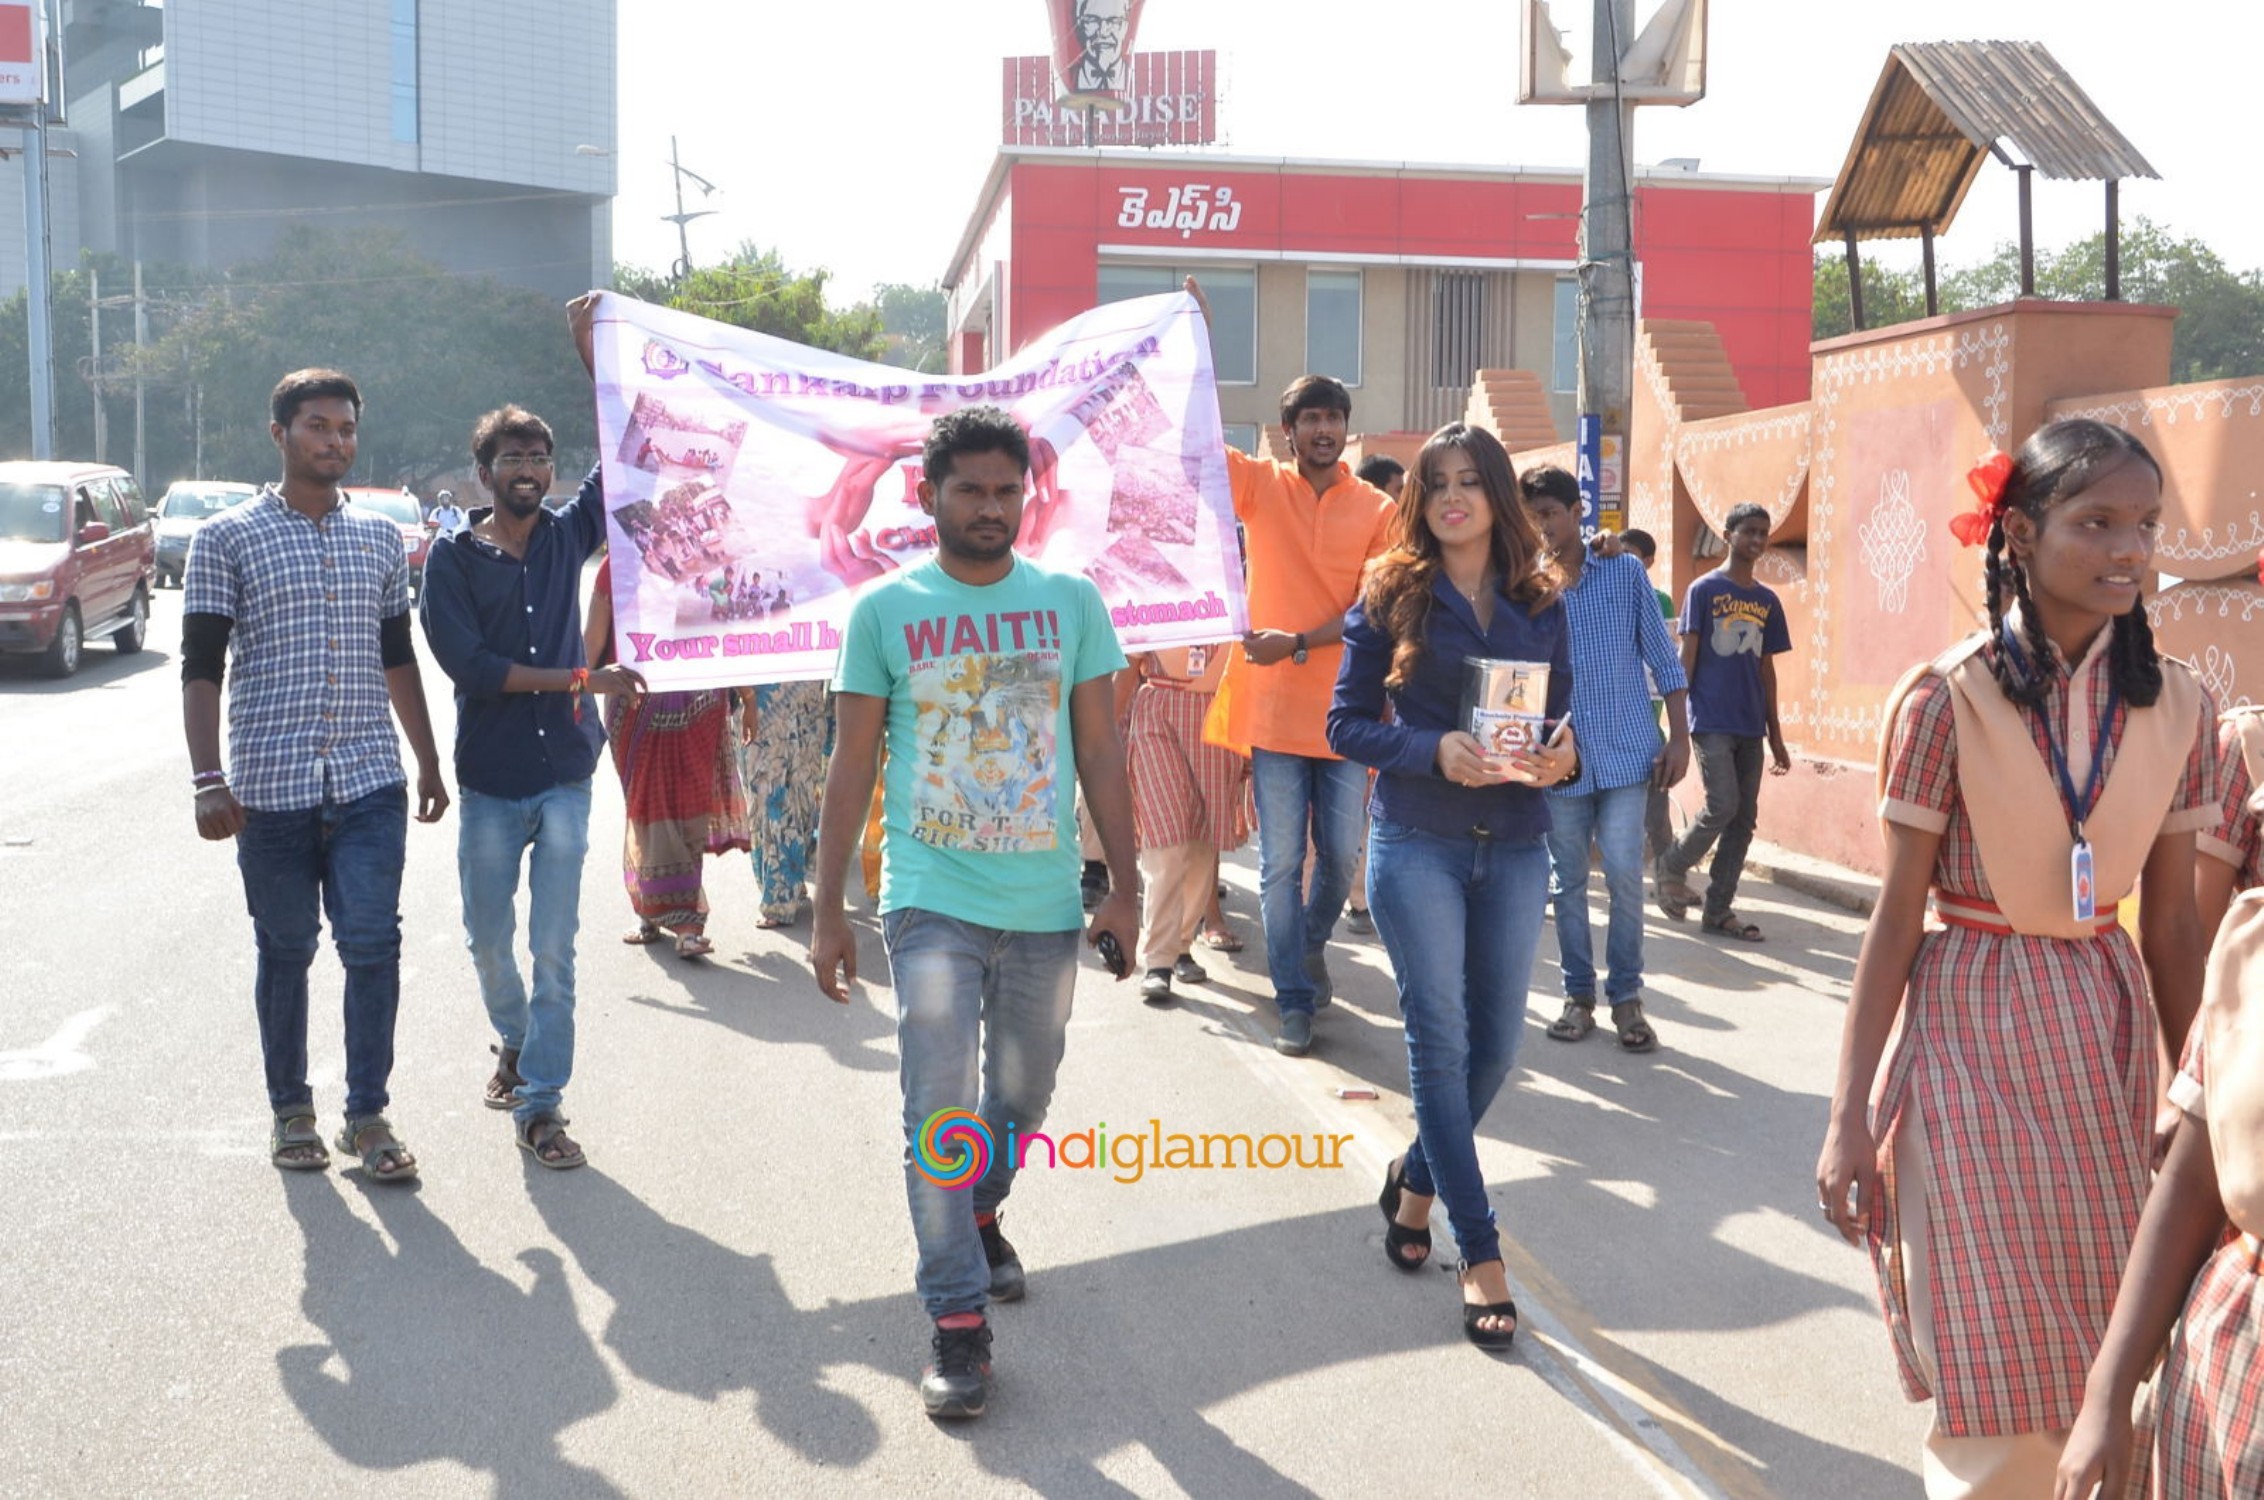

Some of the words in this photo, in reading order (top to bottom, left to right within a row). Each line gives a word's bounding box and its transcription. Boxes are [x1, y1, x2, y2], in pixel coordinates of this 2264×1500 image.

[626, 633, 719, 662] Your
[723, 622, 812, 657] small
[1111, 590, 1228, 628] stomach
[903, 610, 1061, 661] WAIT!!
